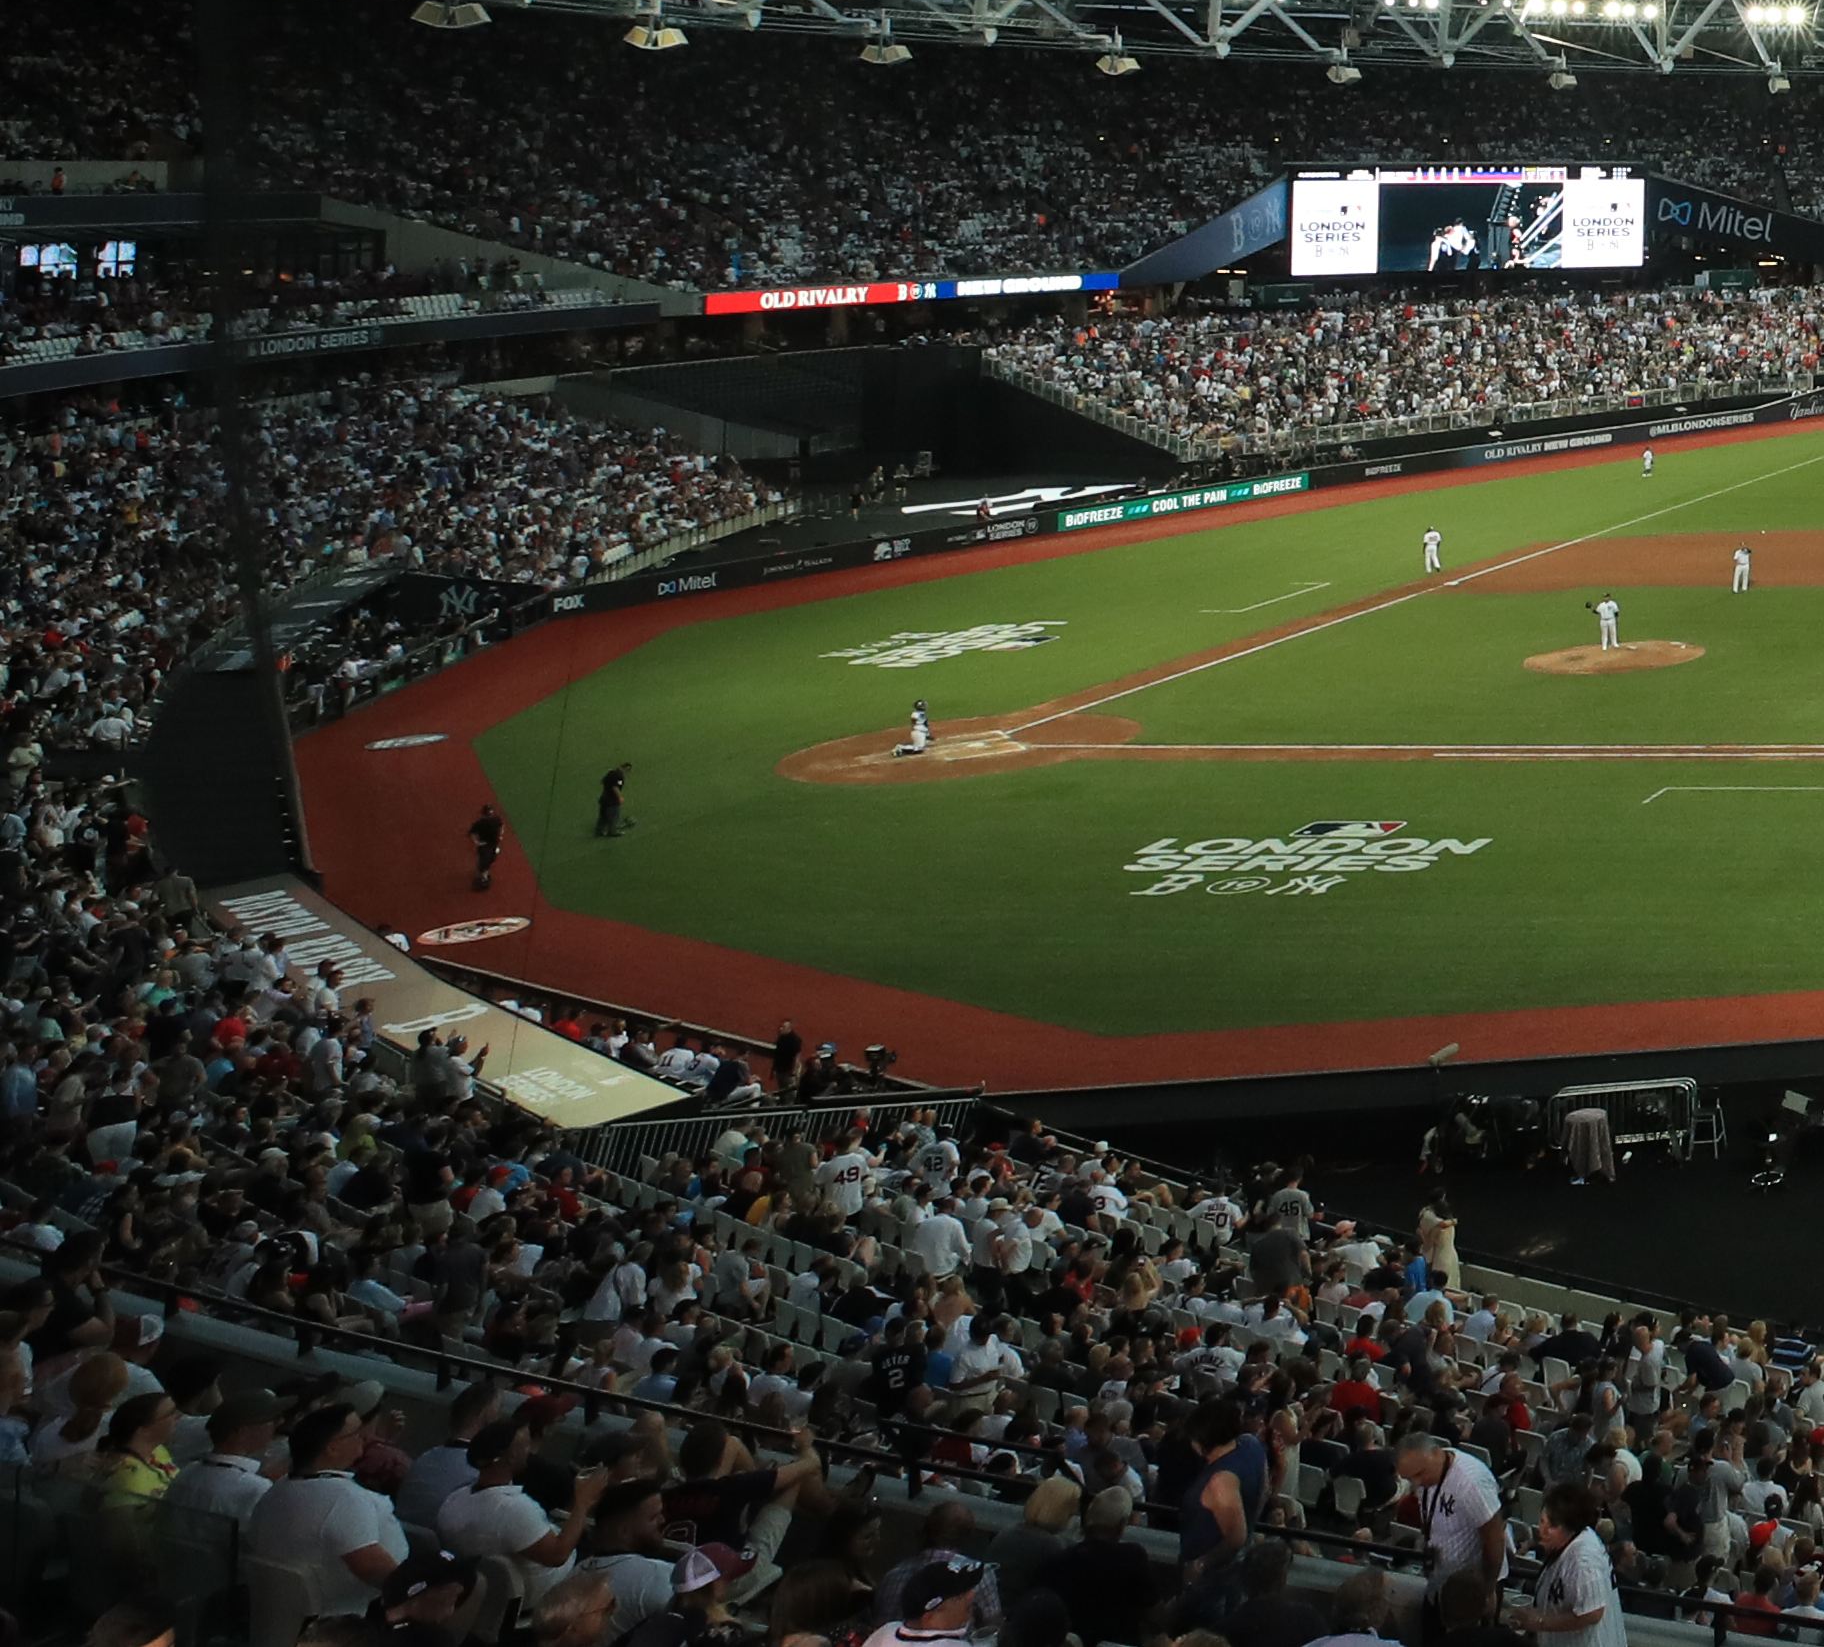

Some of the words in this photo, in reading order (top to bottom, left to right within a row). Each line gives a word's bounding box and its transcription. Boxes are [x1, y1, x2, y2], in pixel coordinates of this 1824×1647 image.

[1300, 221, 1365, 232] LONDON
[1573, 217, 1634, 228] LONDON
[1577, 227, 1630, 237] SERIES
[1697, 201, 1773, 243] Mitel
[1304, 232, 1360, 243] SERIES
[760, 291, 796, 309] OLD
[798, 286, 868, 307] RIVALRY
[957, 280, 1002, 296] NEW
[1003, 276, 1083, 293] GROUND
[260, 336, 316, 356] LONDON
[320, 330, 369, 349] SERIES
[1649, 412, 1754, 438] @MLBLONDONSERIES
[1484, 448, 1504, 460] OLD
[1506, 442, 1542, 457] RIVALRY
[1544, 439, 1569, 452] NEW
[1569, 433, 1612, 448] GROUND
[1152, 499, 1179, 514] COOL
[1182, 494, 1201, 507] THE
[1204, 490, 1227, 504] PAIN
[987, 519, 1025, 533] LONDON
[439, 584, 480, 616] NY
[553, 594, 585, 613] FOX
[679, 571, 718, 592] Mitel
[1133, 838, 1493, 855] LONDON
[1123, 854, 1440, 872] SERIES
[1129, 873, 1206, 896] B
[923, 1156, 943, 1172] 42
[834, 1166, 860, 1185] 49
[1279, 1200, 1299, 1216] 46
[888, 1368, 905, 1389] 2
